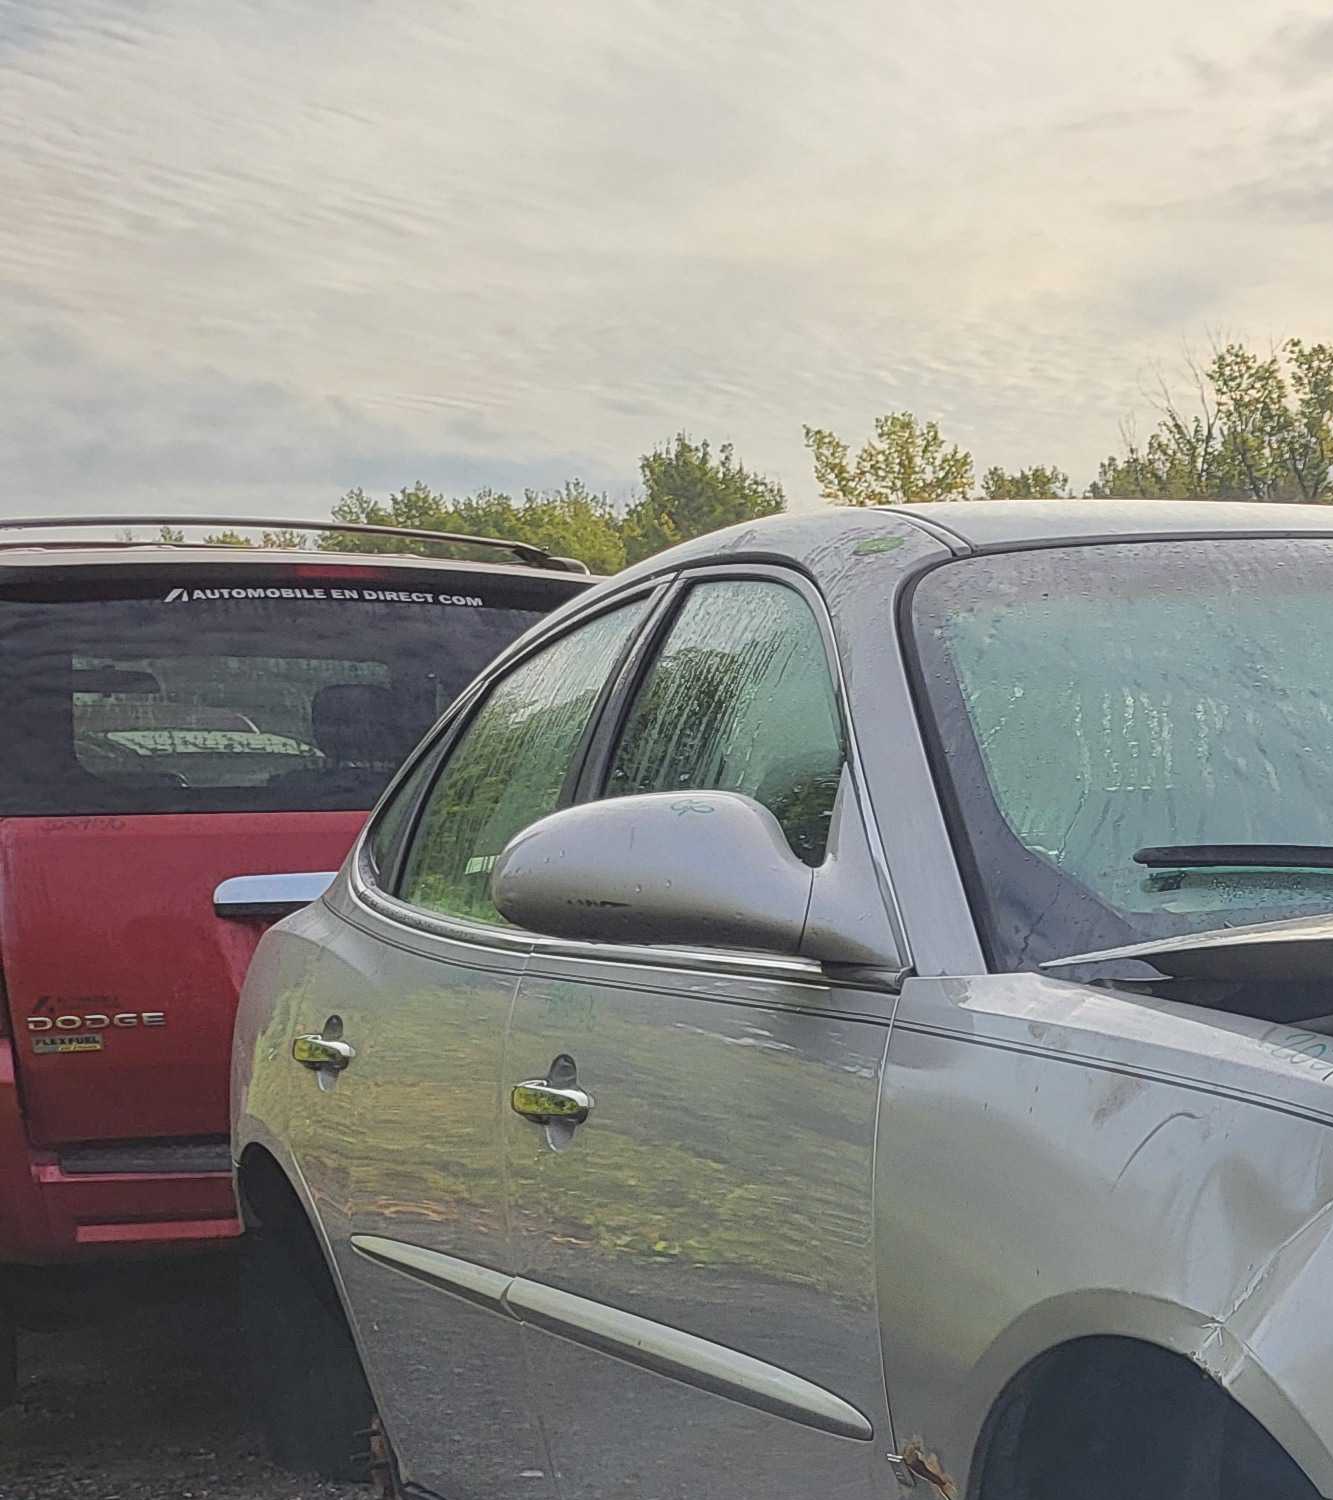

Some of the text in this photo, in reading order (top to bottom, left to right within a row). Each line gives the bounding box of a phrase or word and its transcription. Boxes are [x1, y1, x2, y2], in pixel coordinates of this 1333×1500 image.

[193, 587, 484, 607] AUTOMOBILE EN DIRECT COM
[26, 1012, 166, 1031] DODGE
